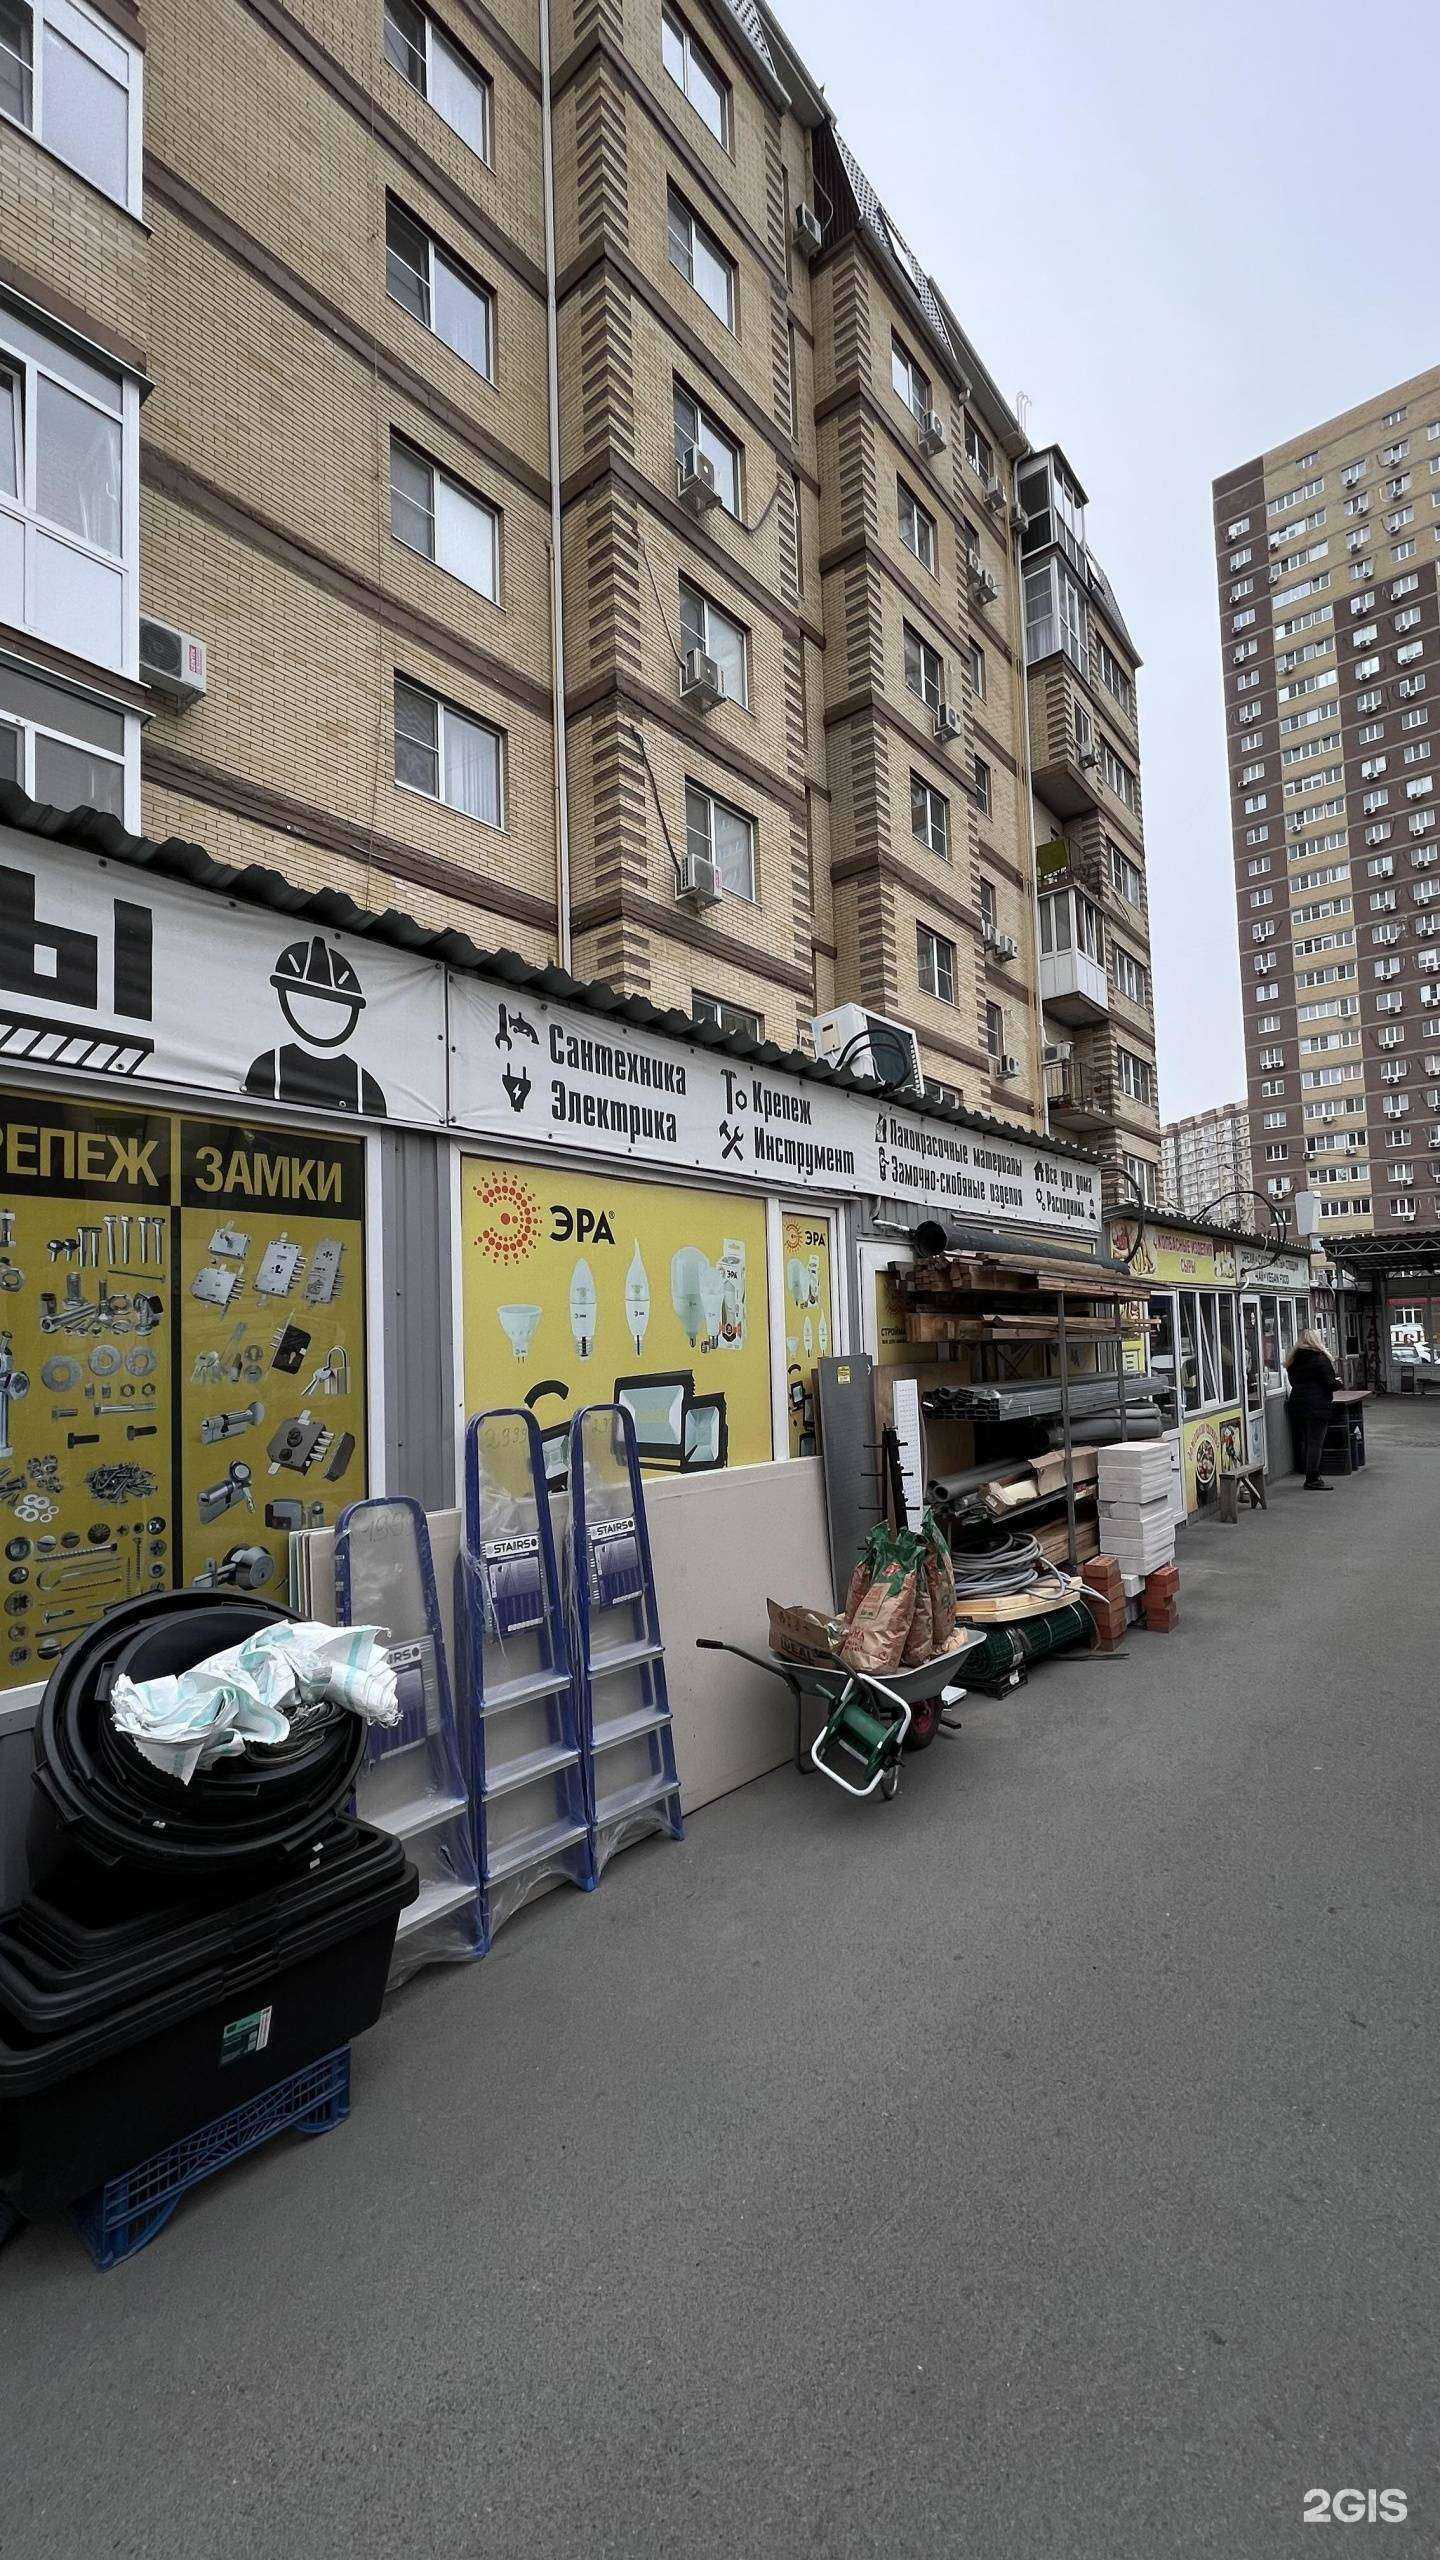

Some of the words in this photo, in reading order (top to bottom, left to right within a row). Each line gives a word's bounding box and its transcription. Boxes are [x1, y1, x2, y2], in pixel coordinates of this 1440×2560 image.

[548, 1023, 688, 1096] Сантехника
[551, 1080, 678, 1144] Электрика
[752, 1080, 812, 1125] Крепеж
[0, 1123, 160, 1187] ЕПЕЖ
[194, 1145, 342, 1203] ЗАМКИ
[754, 1126, 855, 1176] Инструмент
[972, 1147, 1023, 1178] материалы
[891, 1155, 986, 1200] Замочно-скобяные
[989, 1182, 1024, 1209] изделия
[493, 1539, 531, 1554] STAIRS
[596, 1522, 629, 1537] STAIRS
